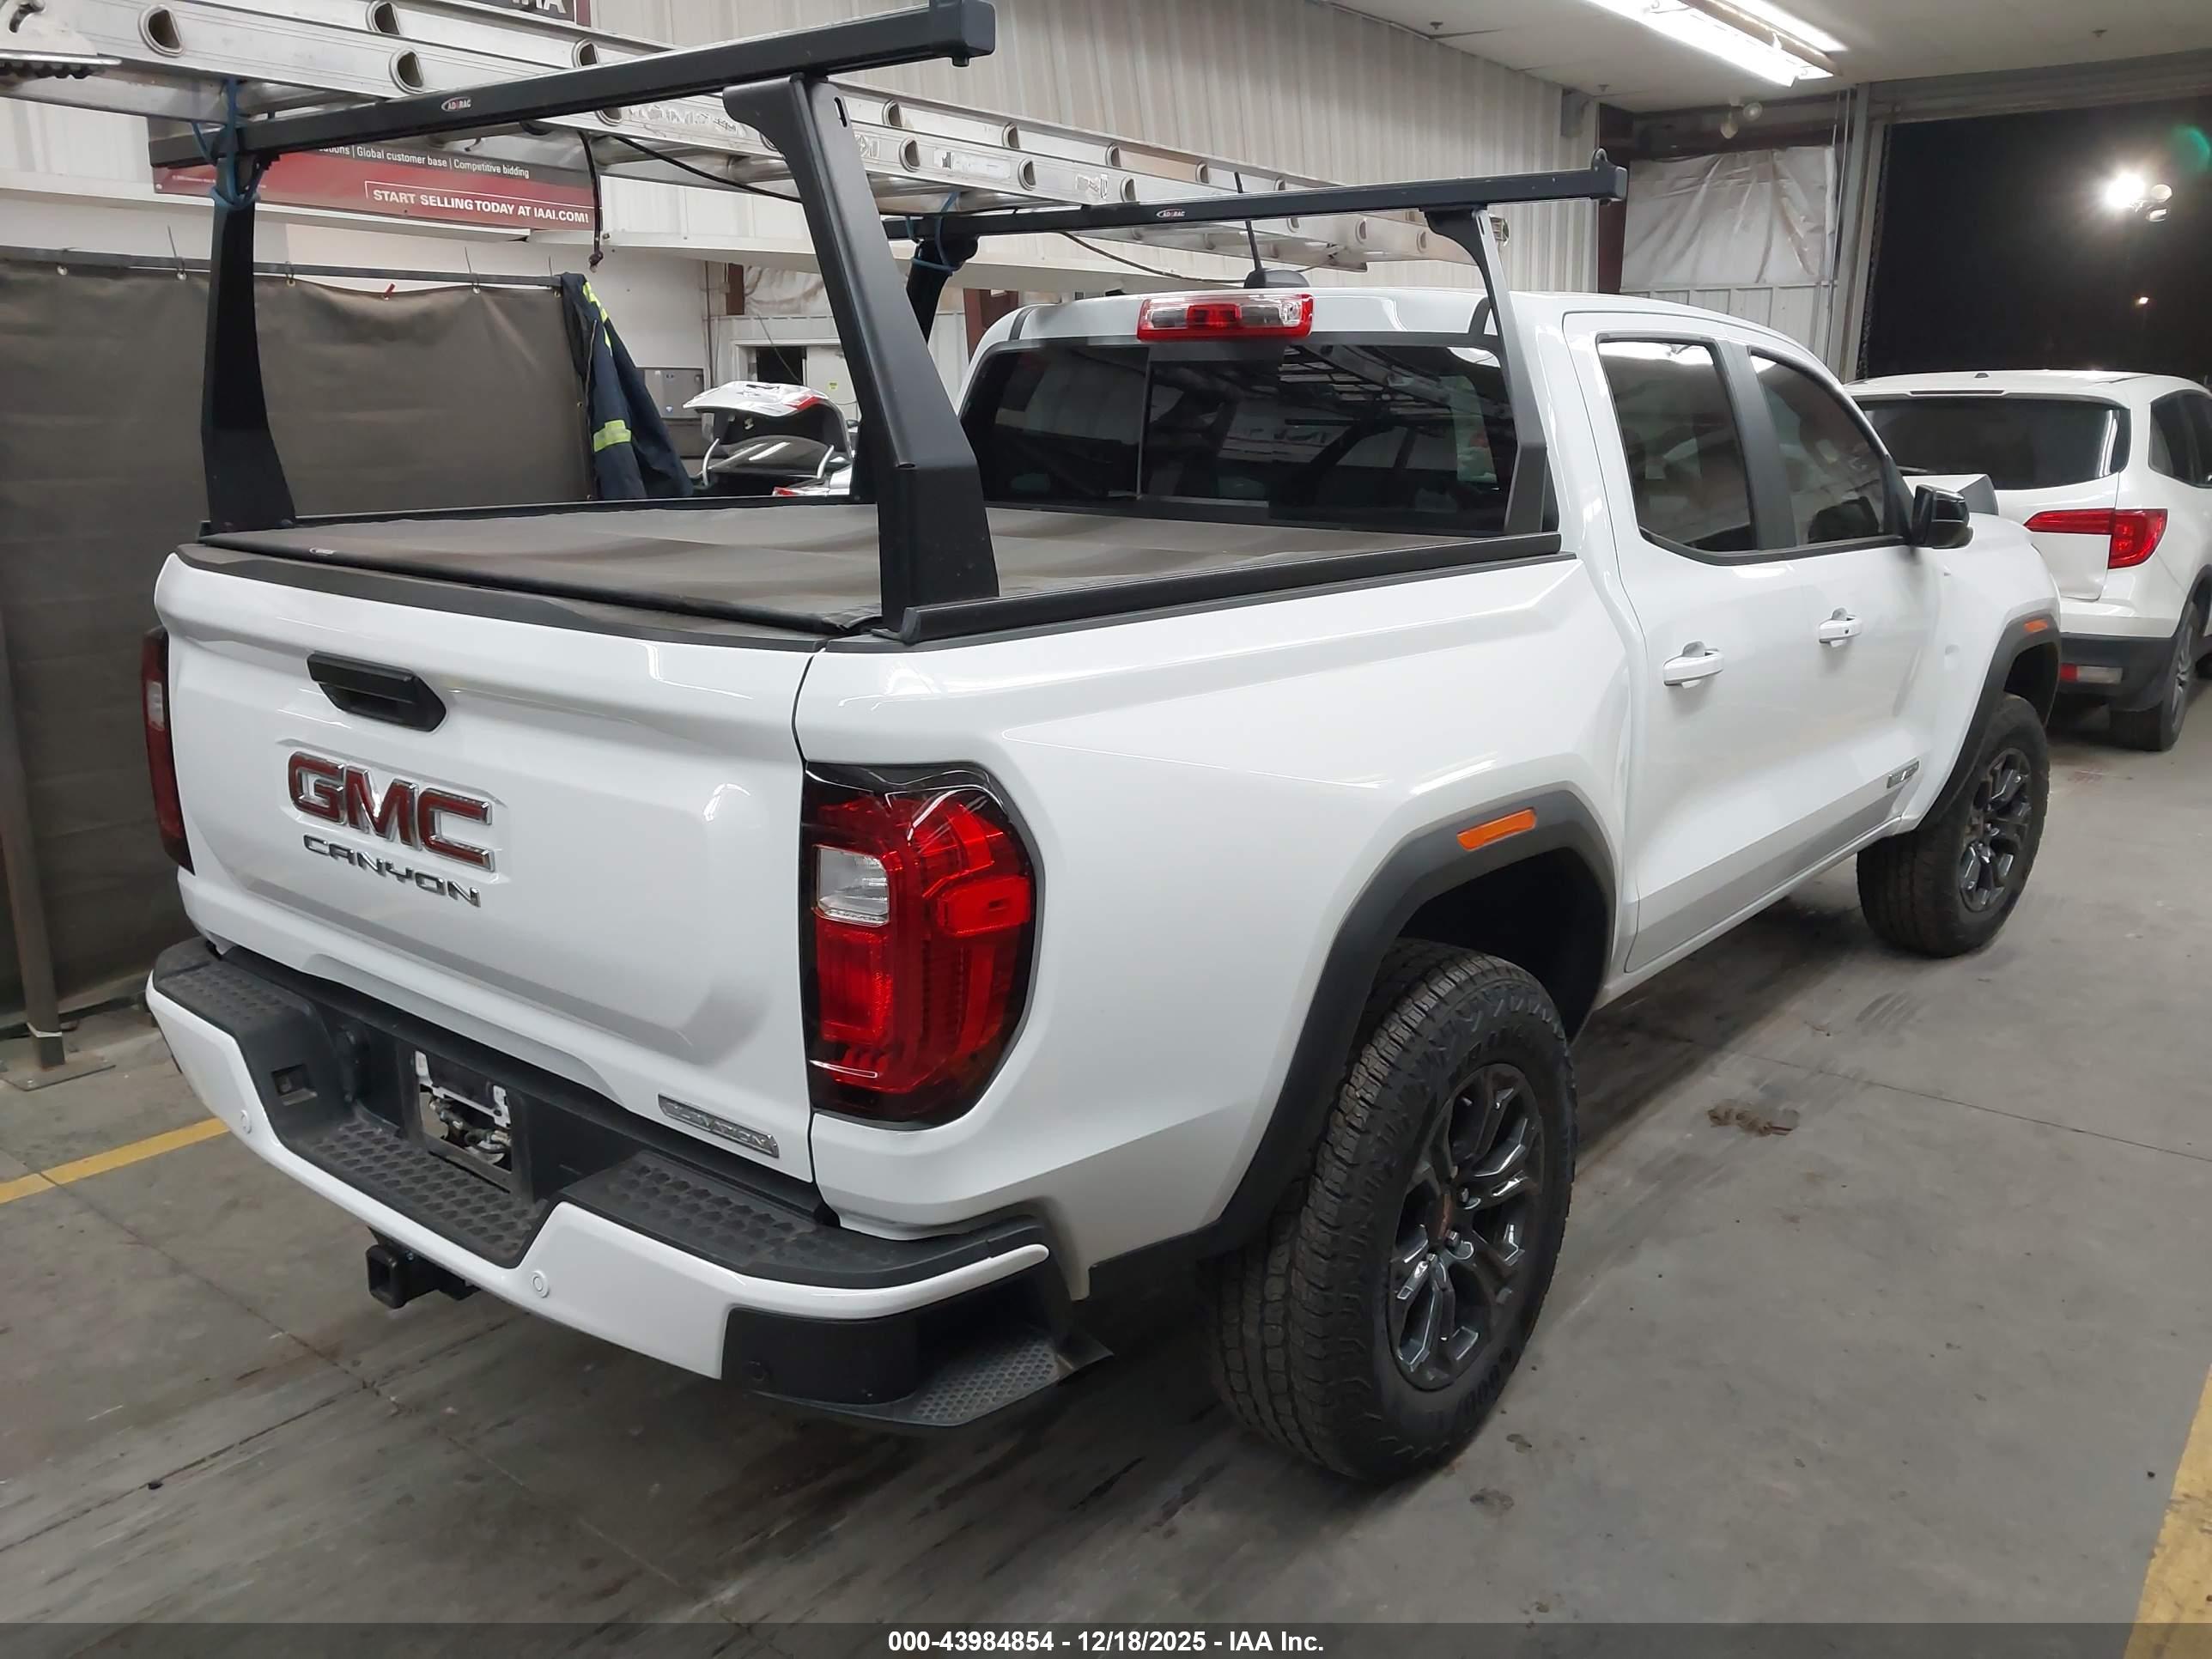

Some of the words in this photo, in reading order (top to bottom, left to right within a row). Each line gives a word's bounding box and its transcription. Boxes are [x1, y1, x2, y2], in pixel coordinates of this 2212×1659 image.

[357, 146, 385, 159] Global
[386, 152, 426, 164] customer
[428, 155, 447, 167] base
[453, 159, 501, 173] Competitive
[502, 165, 530, 179] bidding
[373, 189, 416, 204] START
[420, 194, 474, 210] SELLING
[474, 200, 515, 215] TODAY
[517, 205, 531, 216] AT
[533, 207, 590, 223] IAAI.COM!
[288, 750, 495, 872] GMC
[303, 833, 481, 907] CANYON
